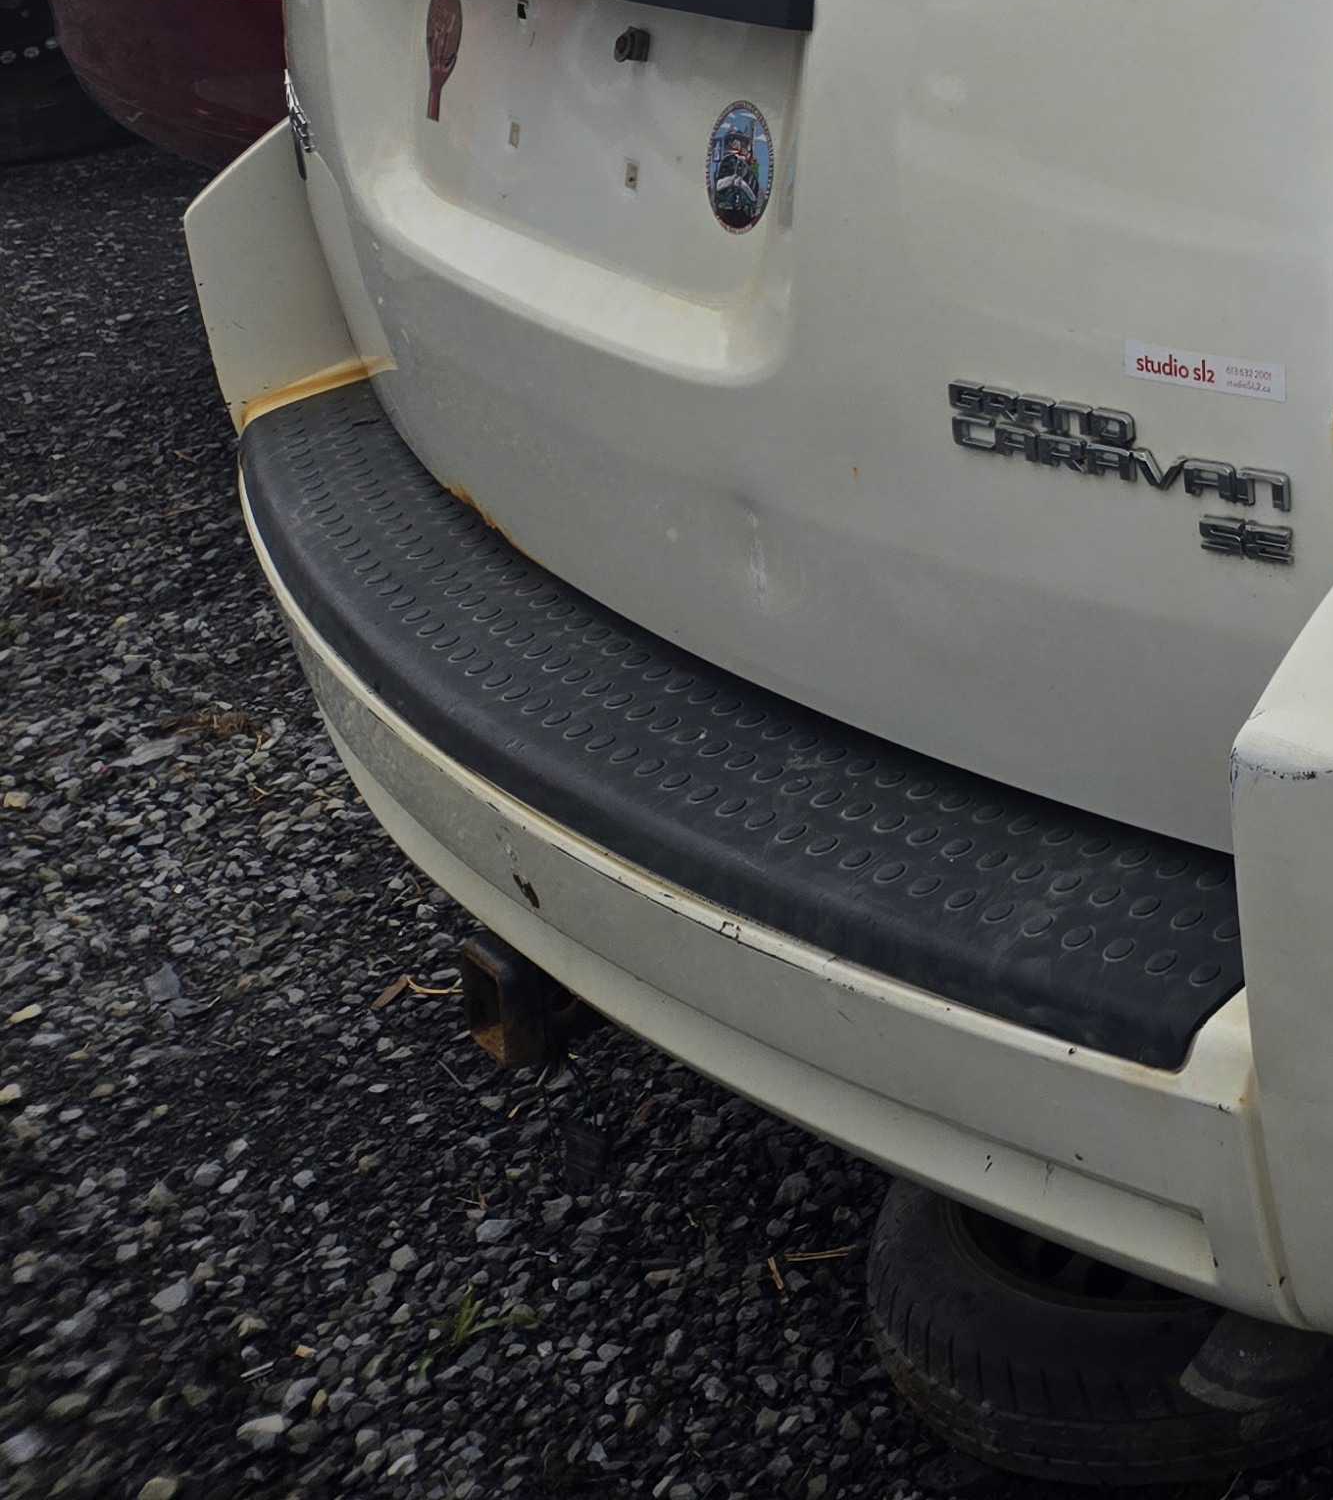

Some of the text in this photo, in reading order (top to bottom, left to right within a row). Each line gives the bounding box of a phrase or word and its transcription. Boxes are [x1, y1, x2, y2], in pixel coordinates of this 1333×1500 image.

[1136, 354, 1190, 380] studio
[948, 379, 1137, 444] GRAND
[952, 414, 1292, 512] CARAVAN
[1200, 514, 1294, 566] SE
